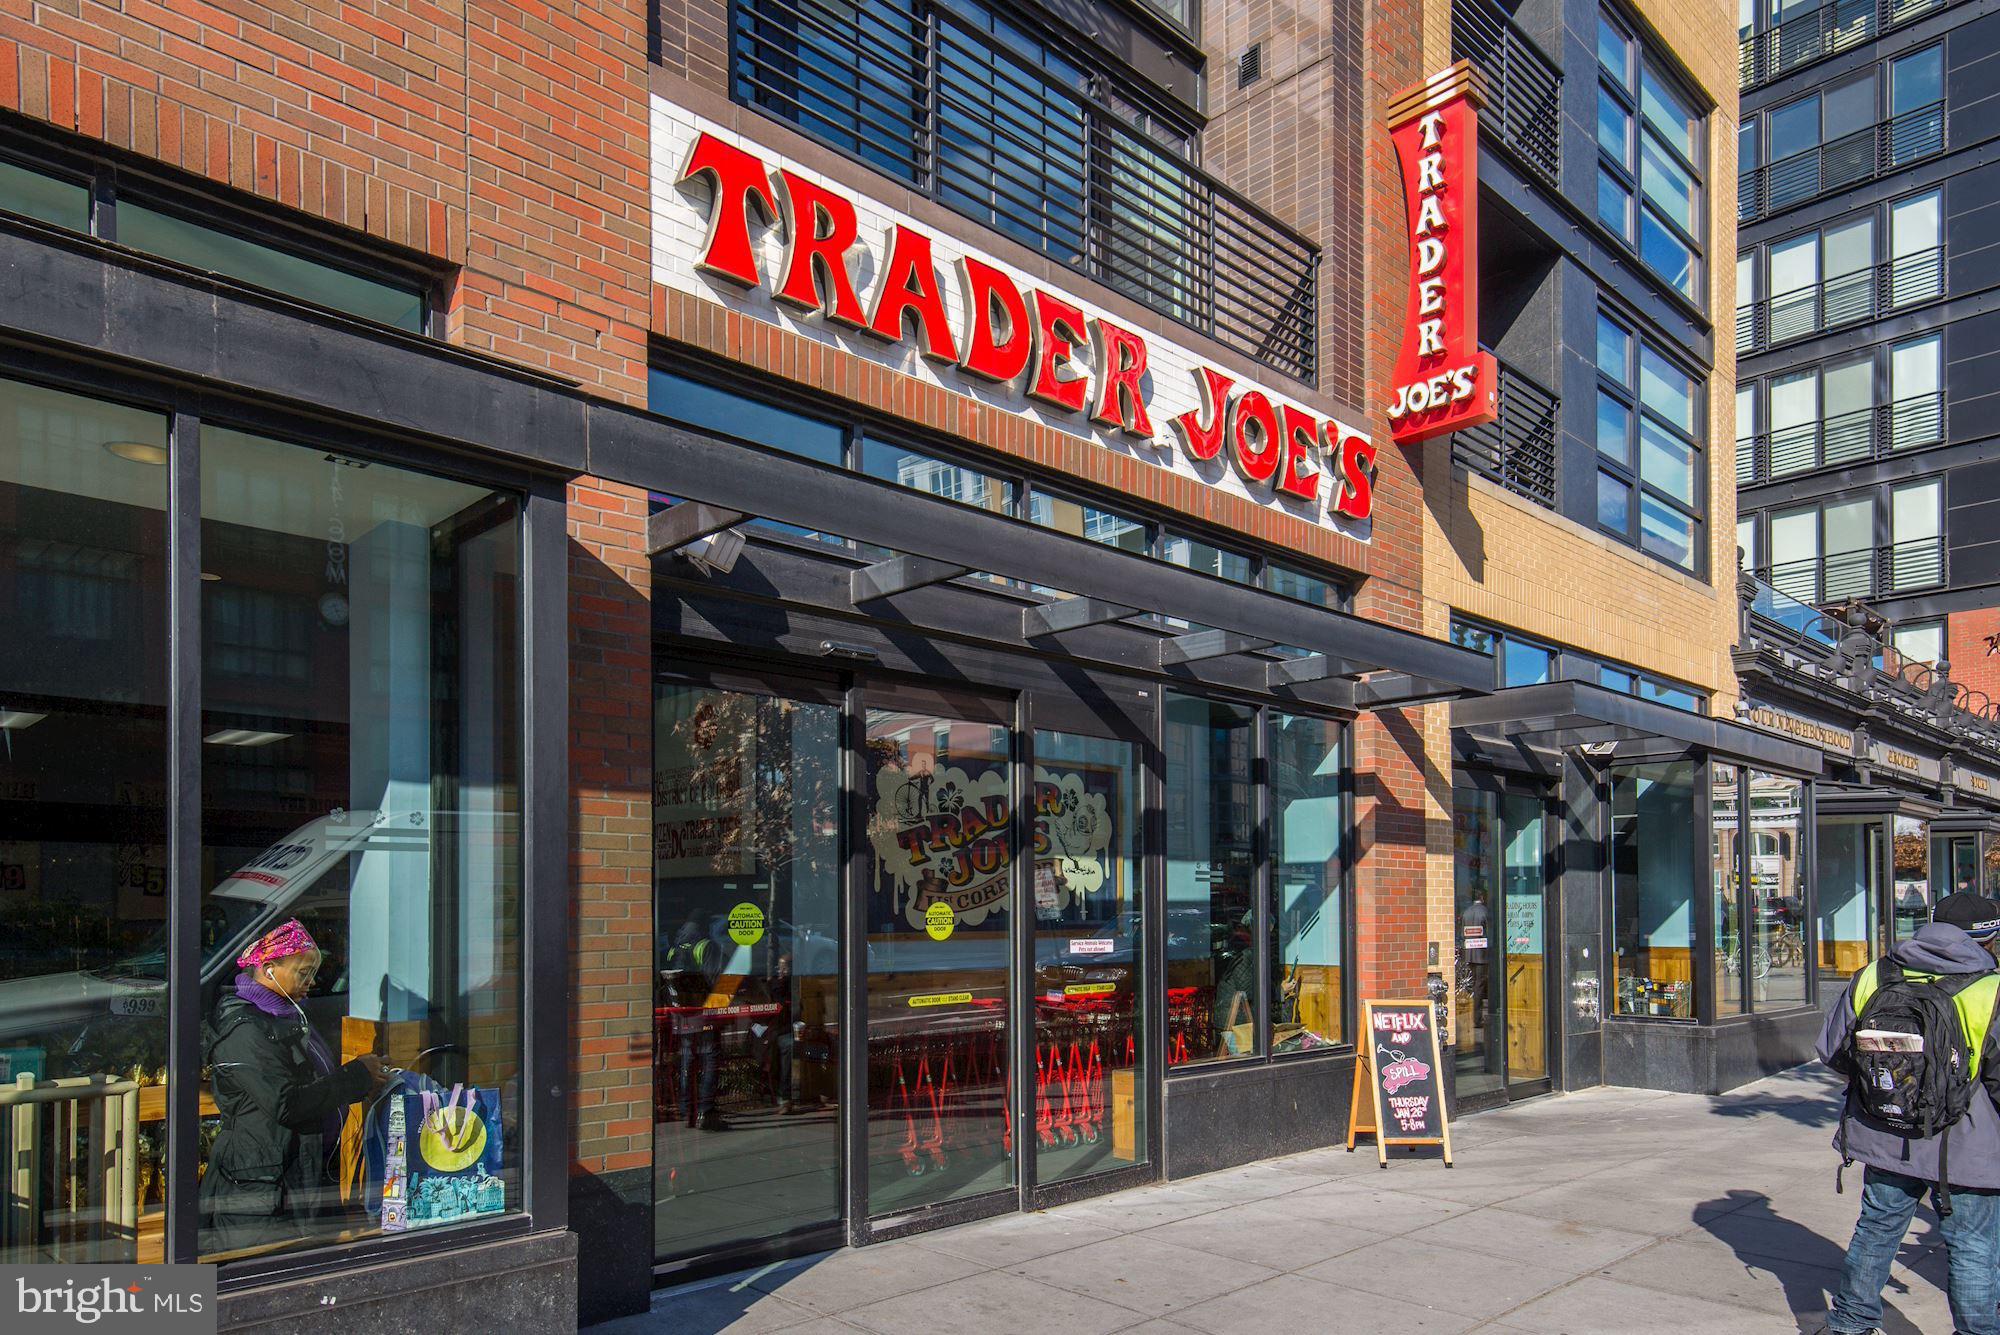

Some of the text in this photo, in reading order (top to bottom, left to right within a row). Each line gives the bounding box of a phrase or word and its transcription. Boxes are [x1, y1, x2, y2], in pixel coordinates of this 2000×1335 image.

[1416, 110, 1449, 358] TRADER
[674, 131, 1378, 519] TRADER JOE'S
[1388, 365, 1479, 420] JOE'S
[1776, 713, 1852, 751] NEIGHBORHOOD
[896, 782, 1067, 866] TRADR
[730, 920, 762, 929] CAUTION
[927, 917, 953, 925] CAUTION
[703, 1007, 728, 1016] AUTOMATIC
[728, 1006, 740, 1014] DOOR
[750, 1004, 764, 1012] STAND
[764, 1003, 778, 1012] CLEAR
[1373, 1012, 1428, 1031] NETFLIX
[1391, 1032, 1412, 1045] AND
[1389, 1065, 1419, 1080] SPILL
[1388, 1096, 1429, 1110] THURSDAY
[1394, 1107, 1410, 1119] JAN
